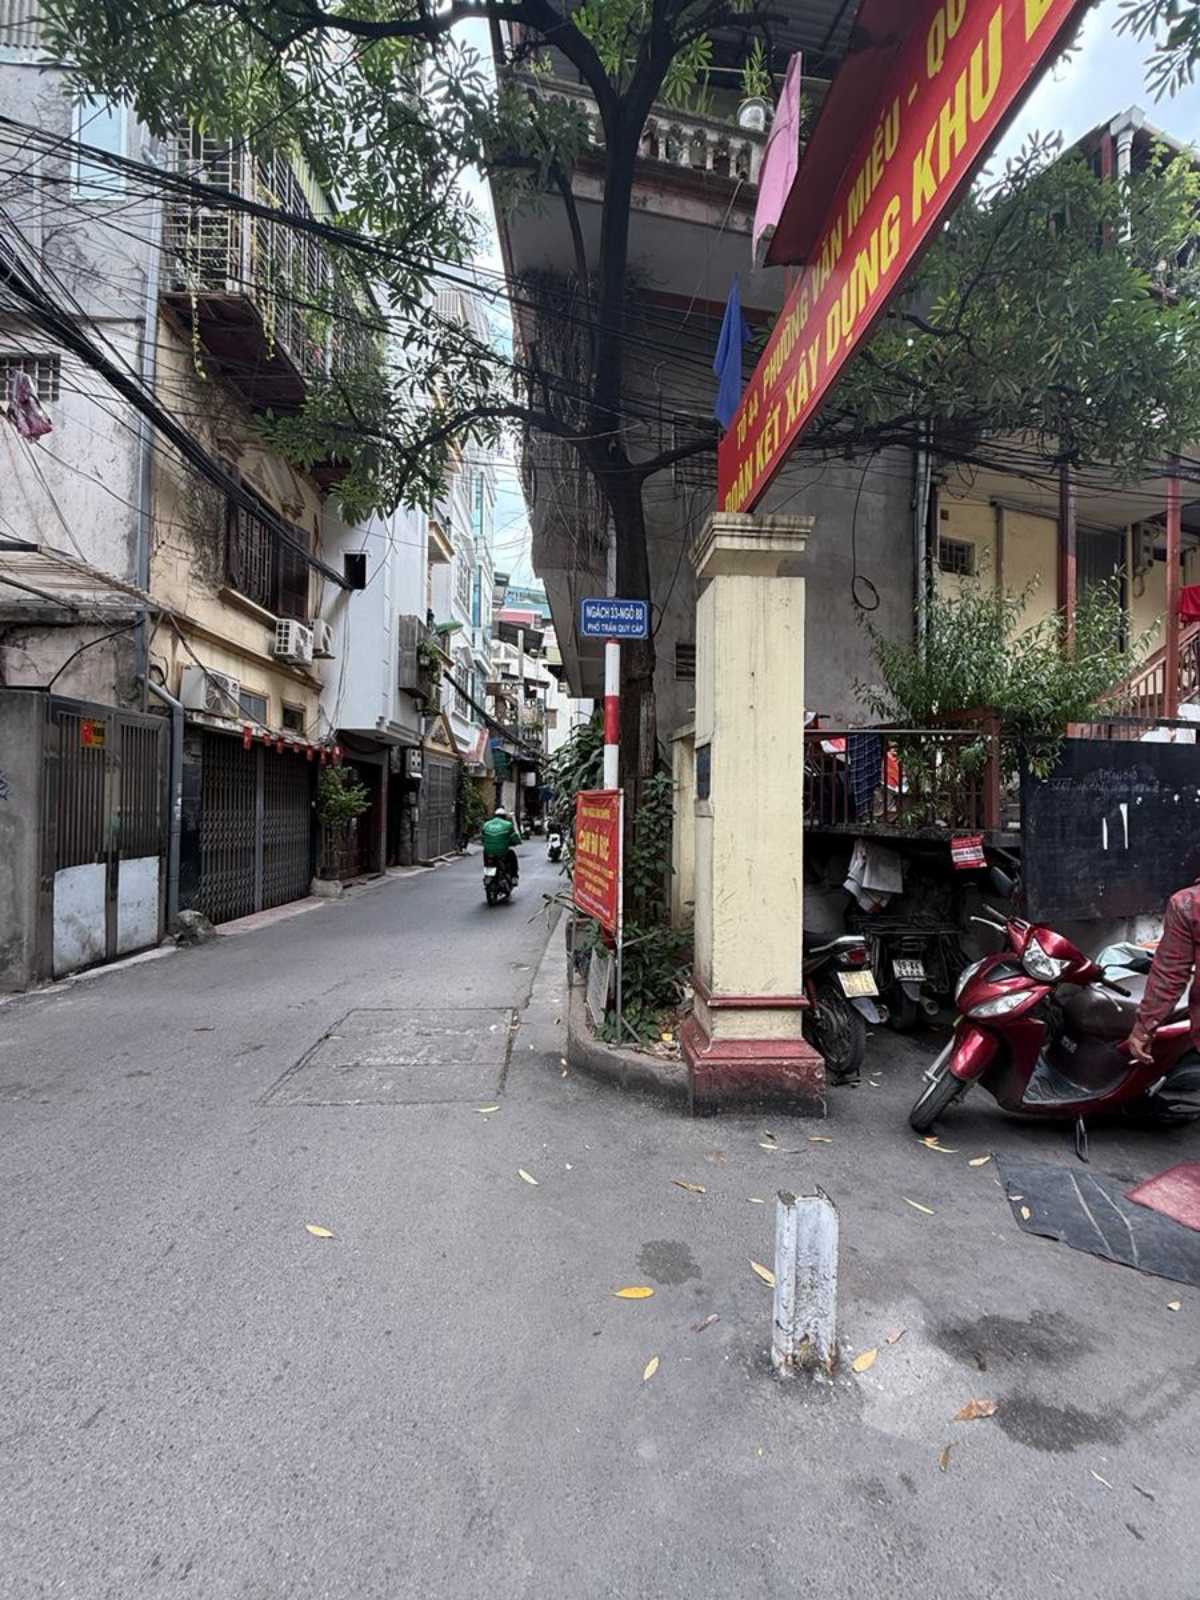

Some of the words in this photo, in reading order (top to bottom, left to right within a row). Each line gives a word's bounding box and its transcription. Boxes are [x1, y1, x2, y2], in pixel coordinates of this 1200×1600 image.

[755, 400, 781, 479] KẾT
[785, 328, 821, 435] XÂY
[826, 193, 901, 366] DỰNG
[911, 3, 1003, 228] KHU
[811, 214, 842, 304] VĂN
[847, 95, 900, 239] MIẾU
